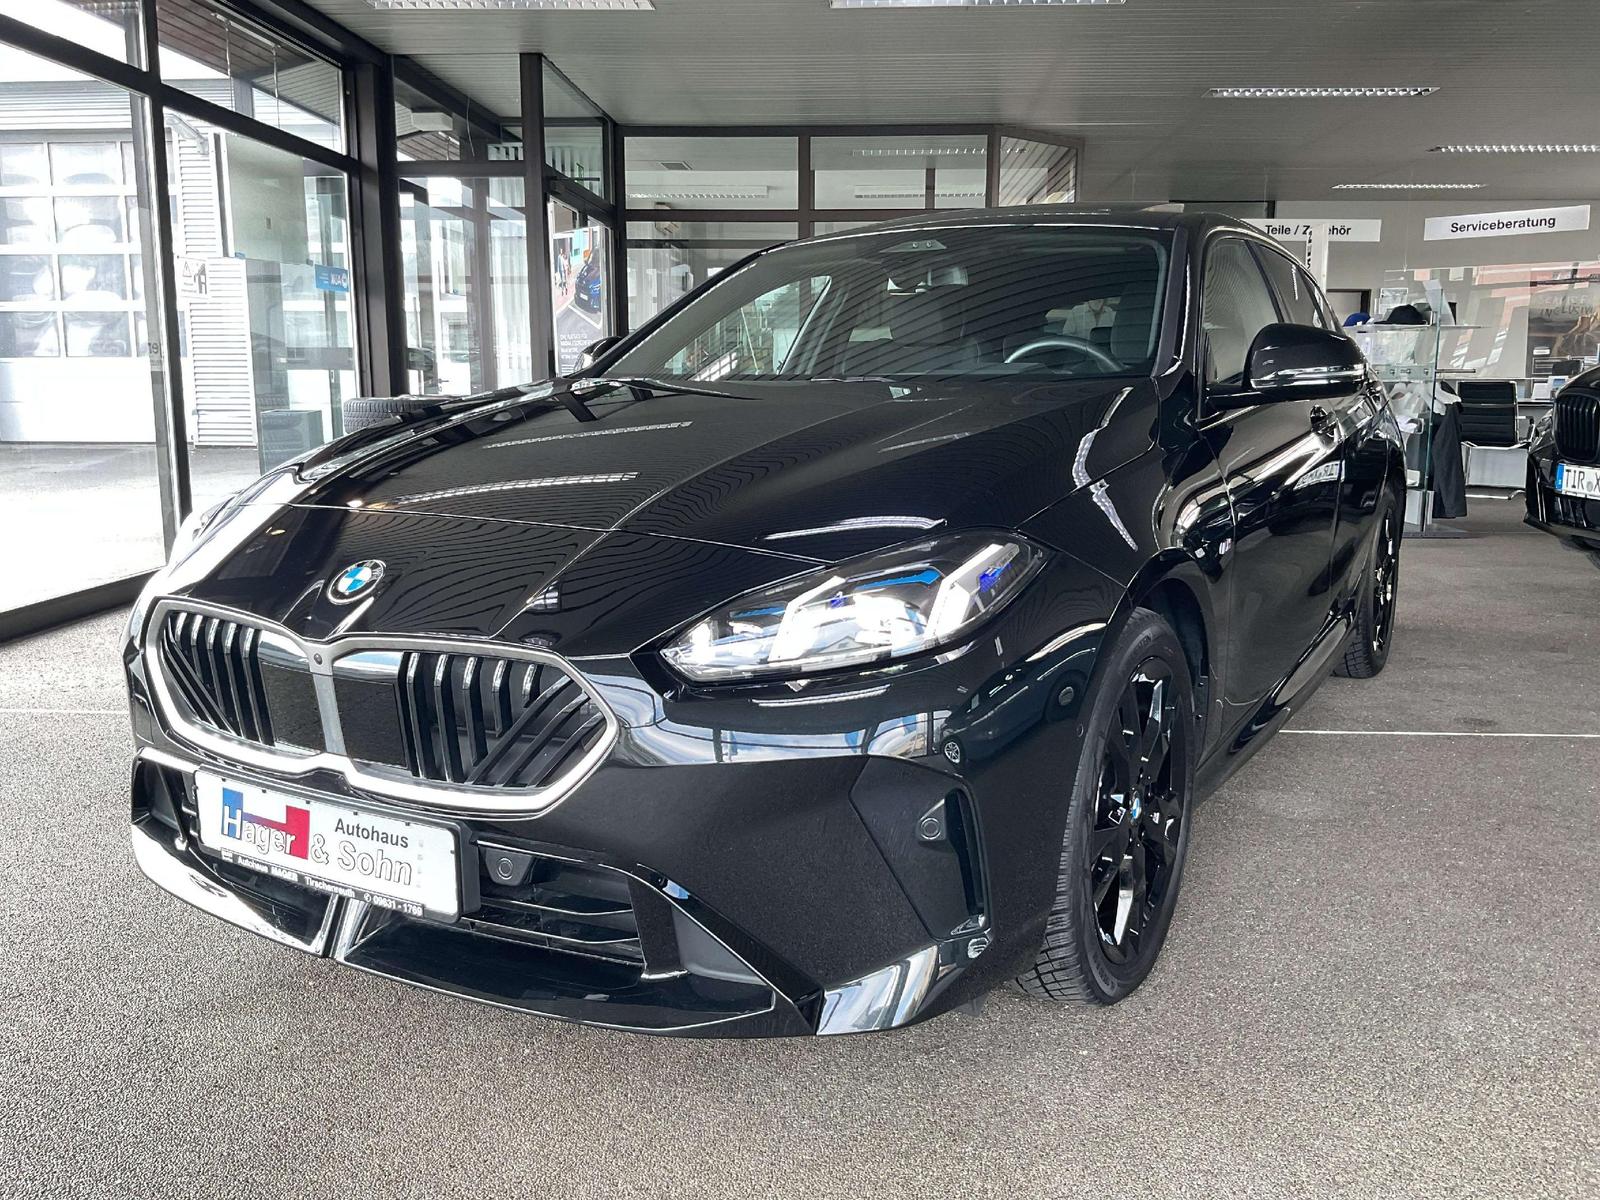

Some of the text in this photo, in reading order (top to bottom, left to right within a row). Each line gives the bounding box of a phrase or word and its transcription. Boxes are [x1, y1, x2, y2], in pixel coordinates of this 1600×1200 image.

[1265, 224, 1352, 235] Teile / Zhör
[1450, 217, 1556, 233] Serviceberatung
[1565, 468, 1585, 490] TIR
[335, 818, 409, 848] Autohaus
[223, 805, 413, 886] Hager & Sohn
